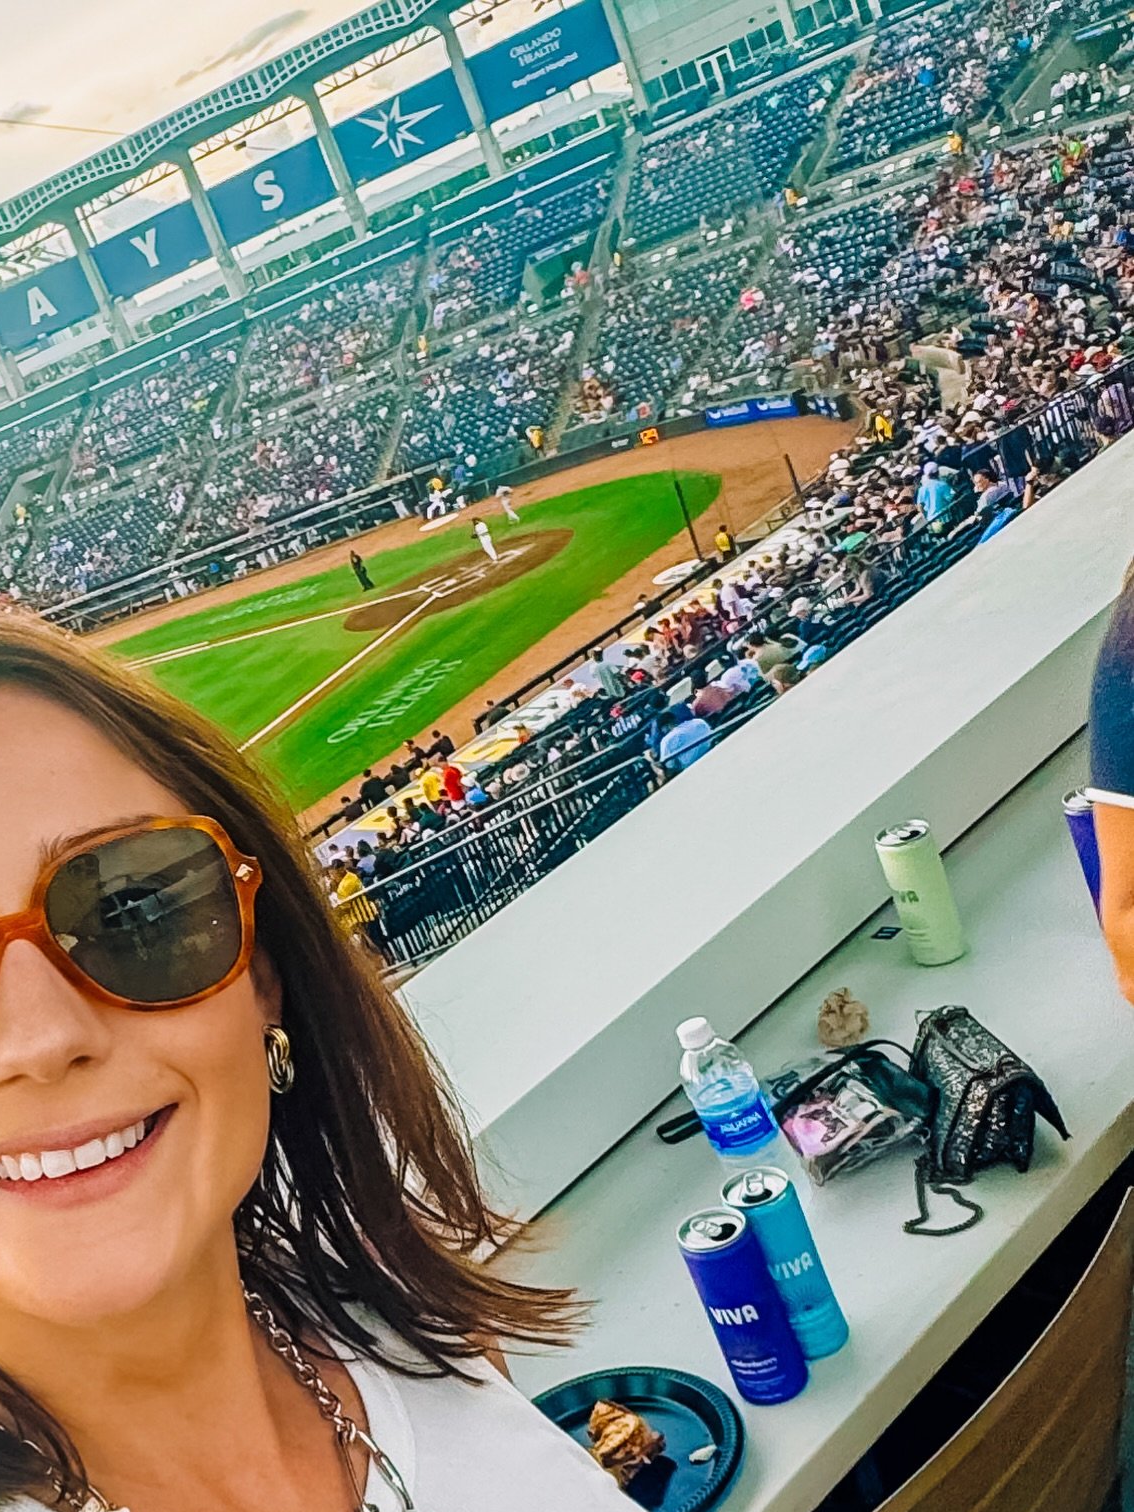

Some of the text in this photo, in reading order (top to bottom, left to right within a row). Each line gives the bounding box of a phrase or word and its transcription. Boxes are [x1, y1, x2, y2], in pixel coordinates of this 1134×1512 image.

[509, 27, 562, 59] ORLANDO
[518, 39, 561, 67] HEALTH
[366, 660, 462, 729] HEALTH
[767, 1251, 814, 1281] VIVA
[709, 1304, 760, 1326] VIVA
